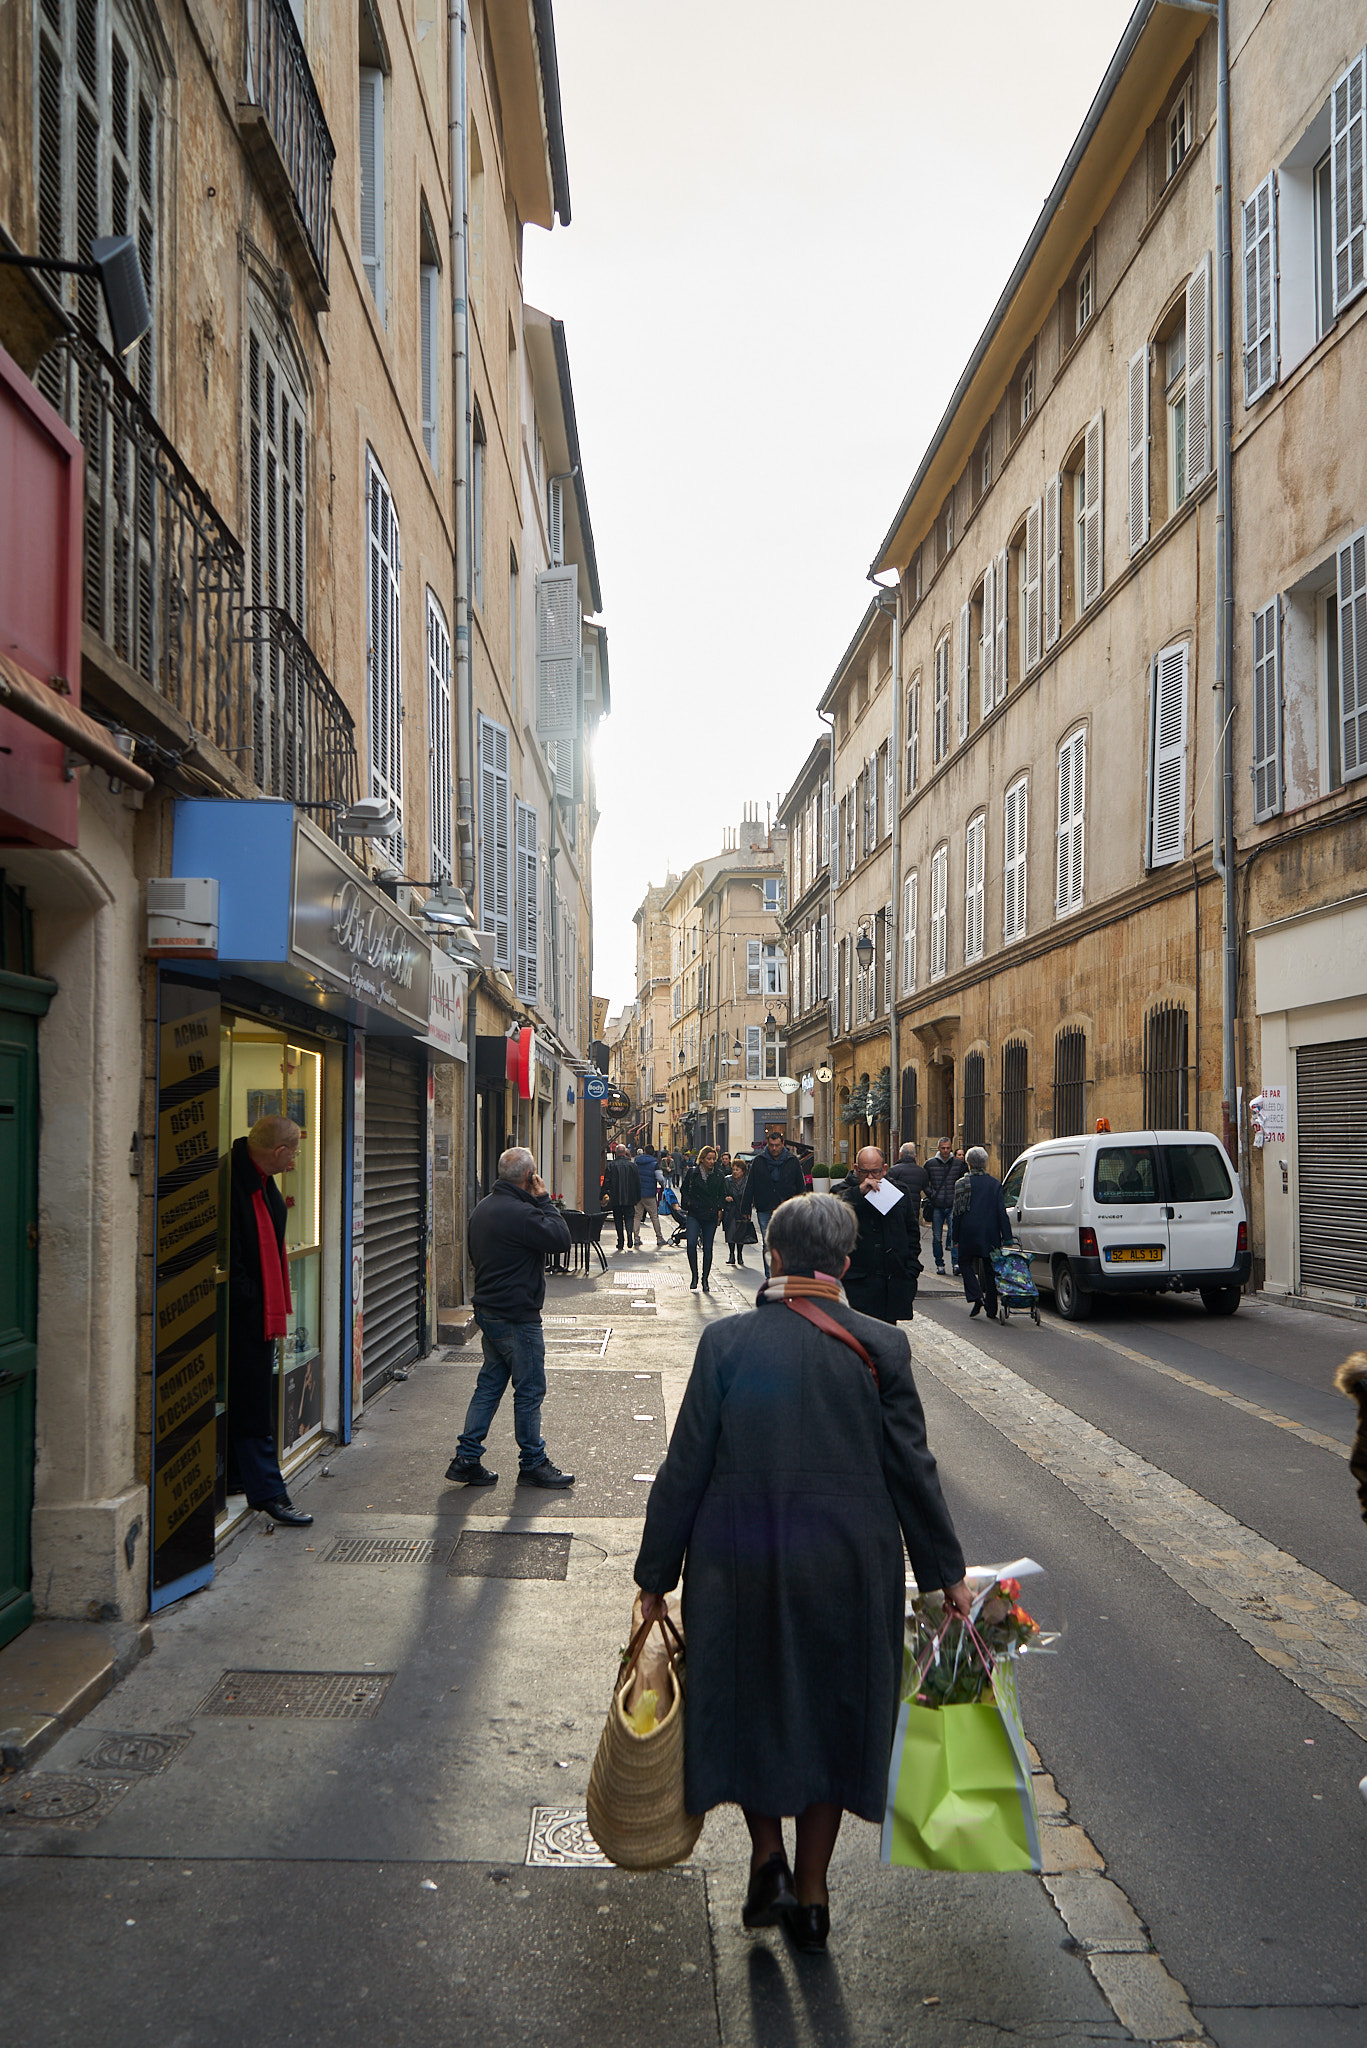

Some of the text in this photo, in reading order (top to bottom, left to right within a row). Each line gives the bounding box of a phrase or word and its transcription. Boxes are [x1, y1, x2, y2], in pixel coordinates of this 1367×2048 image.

[337, 880, 364, 955] Bi
[174, 1016, 209, 1048] ACHAT
[188, 1050, 204, 1073] OR
[1270, 1089, 1281, 1098] PAR
[171, 1101, 205, 1135] DÉPÔT
[175, 1131, 210, 1164] VENTE
[161, 1189, 210, 1228] FABRICATION
[1112, 1249, 1158, 1260] 52 ALS 13
[159, 1272, 216, 1330] RÉPARATION
[159, 1353, 206, 1404] MONTRES
[158, 1371, 216, 1434] D'OCCASION
[163, 1438, 202, 1488] PAIEMENT
[182, 1467, 201, 1496] FOIS
[168, 1474, 213, 1530] SANS FRAIS
